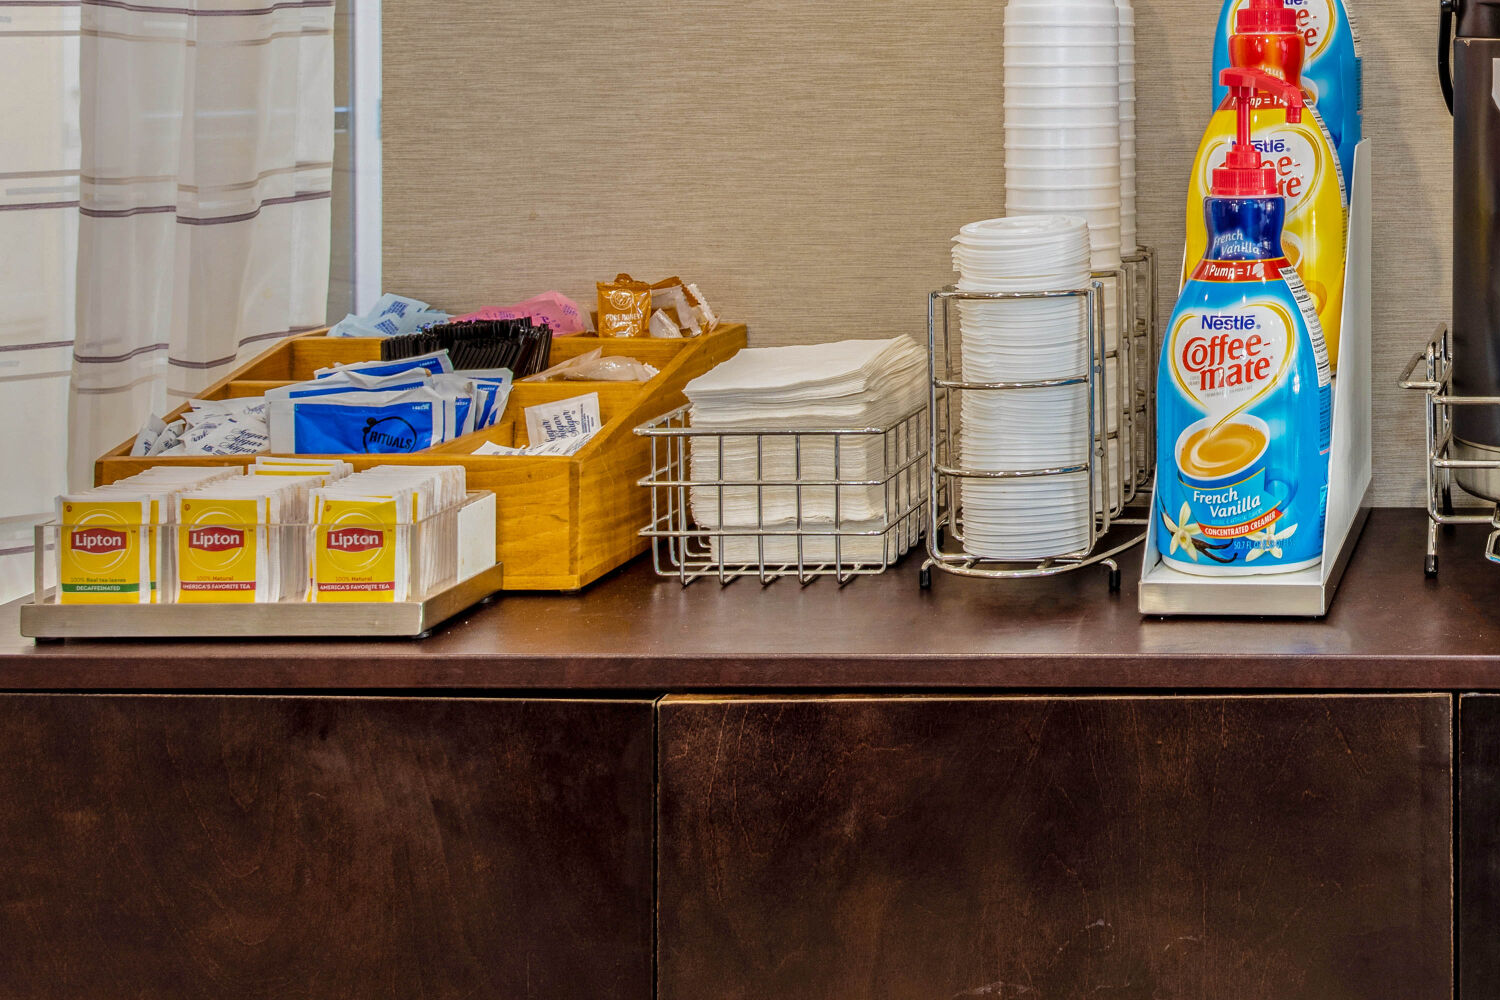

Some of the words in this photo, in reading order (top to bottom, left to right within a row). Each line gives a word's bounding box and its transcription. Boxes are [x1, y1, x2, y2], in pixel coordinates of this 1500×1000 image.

[1213, 228, 1243, 249] French
[1221, 241, 1260, 256] Vanilla
[1203, 264, 1210, 276] 1
[1209, 264, 1236, 280] Pump
[1246, 264, 1252, 277] 1
[1200, 357, 1271, 391] mate
[368, 431, 413, 450] RITUALS
[1193, 487, 1239, 505] French
[1209, 495, 1261, 518] Vanilla
[1204, 525, 1250, 537] CONCENTRATED
[1250, 510, 1277, 531] CREAMER
[75, 533, 122, 549] Lipton
[192, 532, 240, 548] Lipton
[330, 533, 379, 549] Lipton
